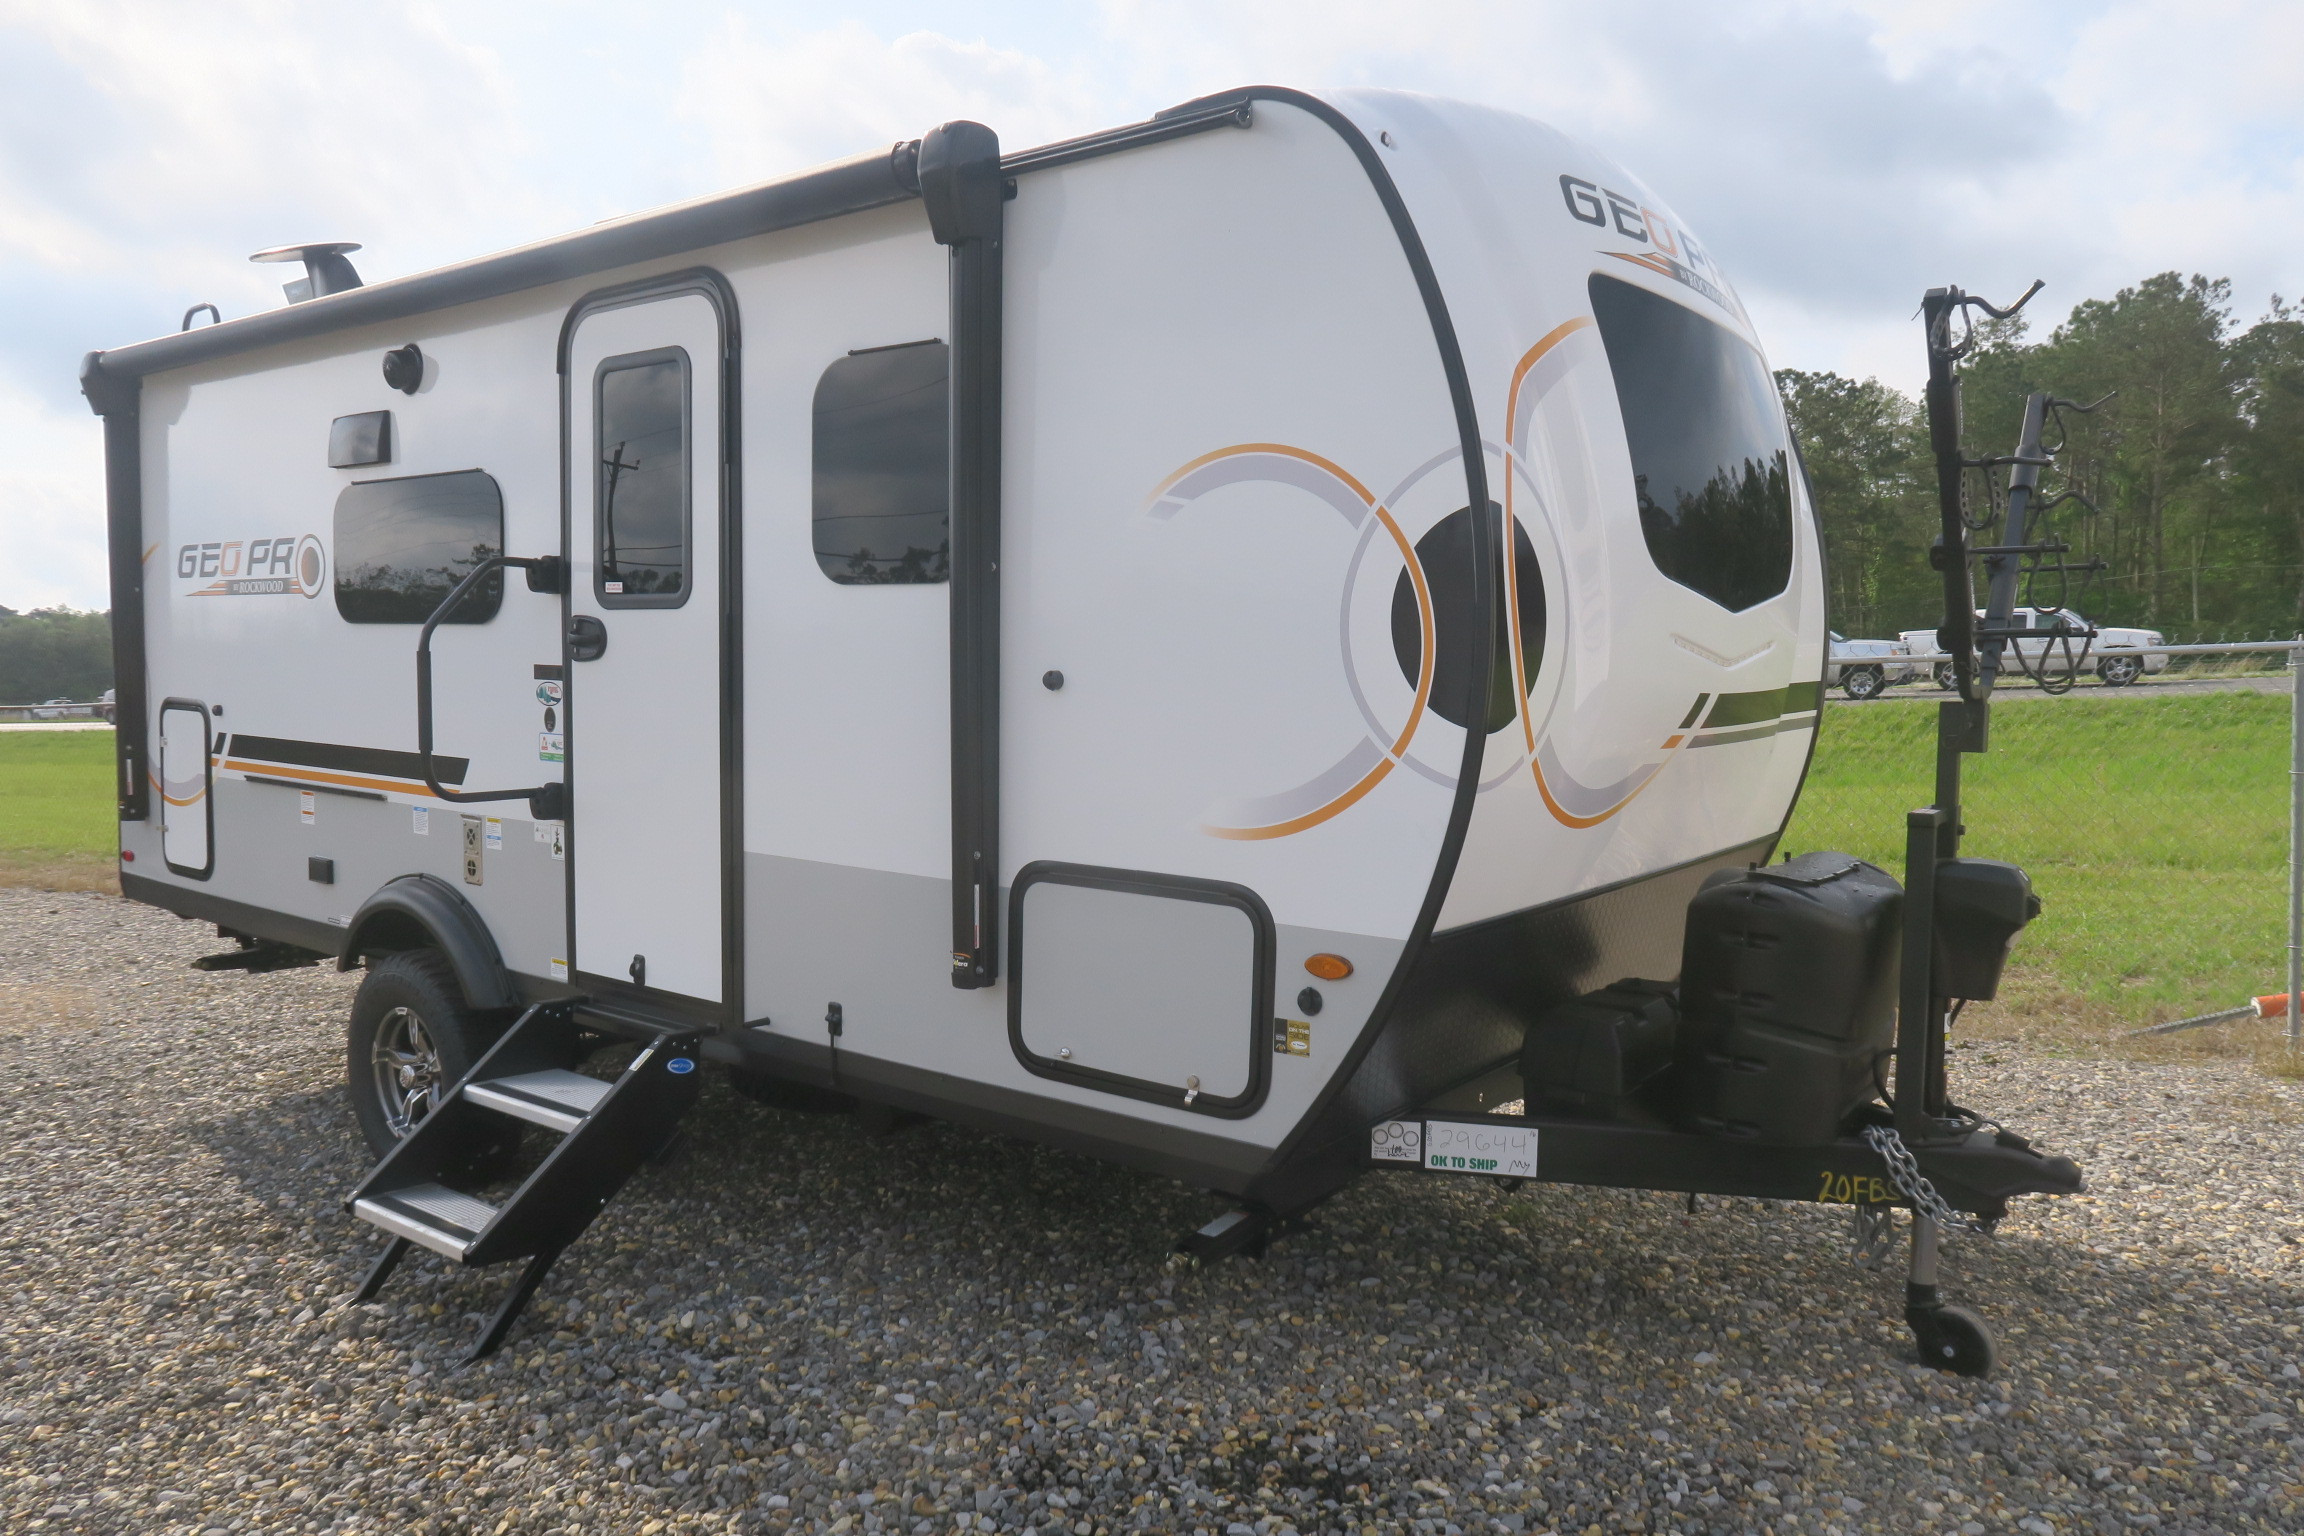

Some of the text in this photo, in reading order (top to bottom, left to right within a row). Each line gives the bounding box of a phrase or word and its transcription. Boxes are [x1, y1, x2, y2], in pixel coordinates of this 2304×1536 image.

[1559, 174, 1678, 258] GEO
[177, 540, 244, 579] GEO
[239, 580, 284, 593] ROCKWOOD
[1440, 1129, 1528, 1154] 29644
[1430, 1154, 1498, 1171] OK TO SHIP
